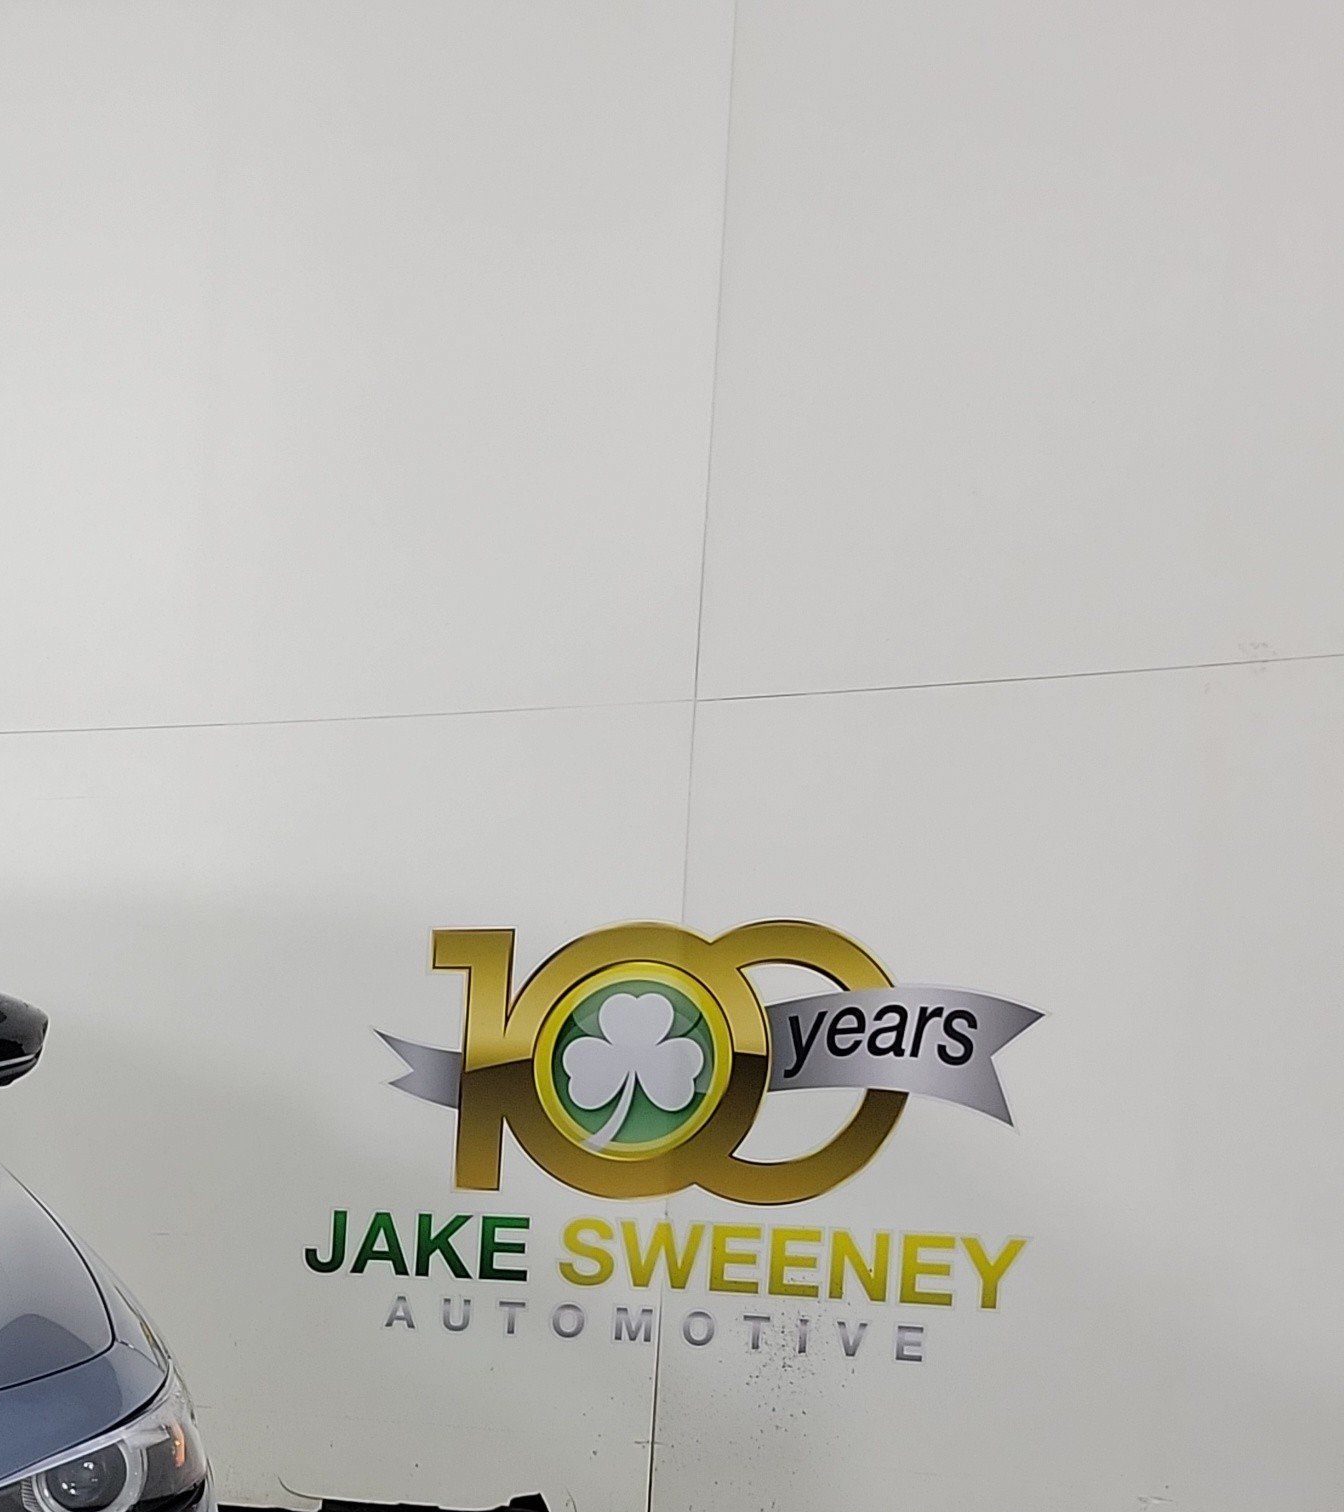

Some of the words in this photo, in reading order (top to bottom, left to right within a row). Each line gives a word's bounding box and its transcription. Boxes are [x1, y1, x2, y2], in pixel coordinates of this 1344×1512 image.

[432, 919, 909, 1206] 100
[782, 1002, 979, 1078] years
[304, 1210, 531, 1282] JAKE
[558, 1218, 1027, 1310] SWEENEY
[385, 1295, 926, 1363] AUTOMOTIVE
